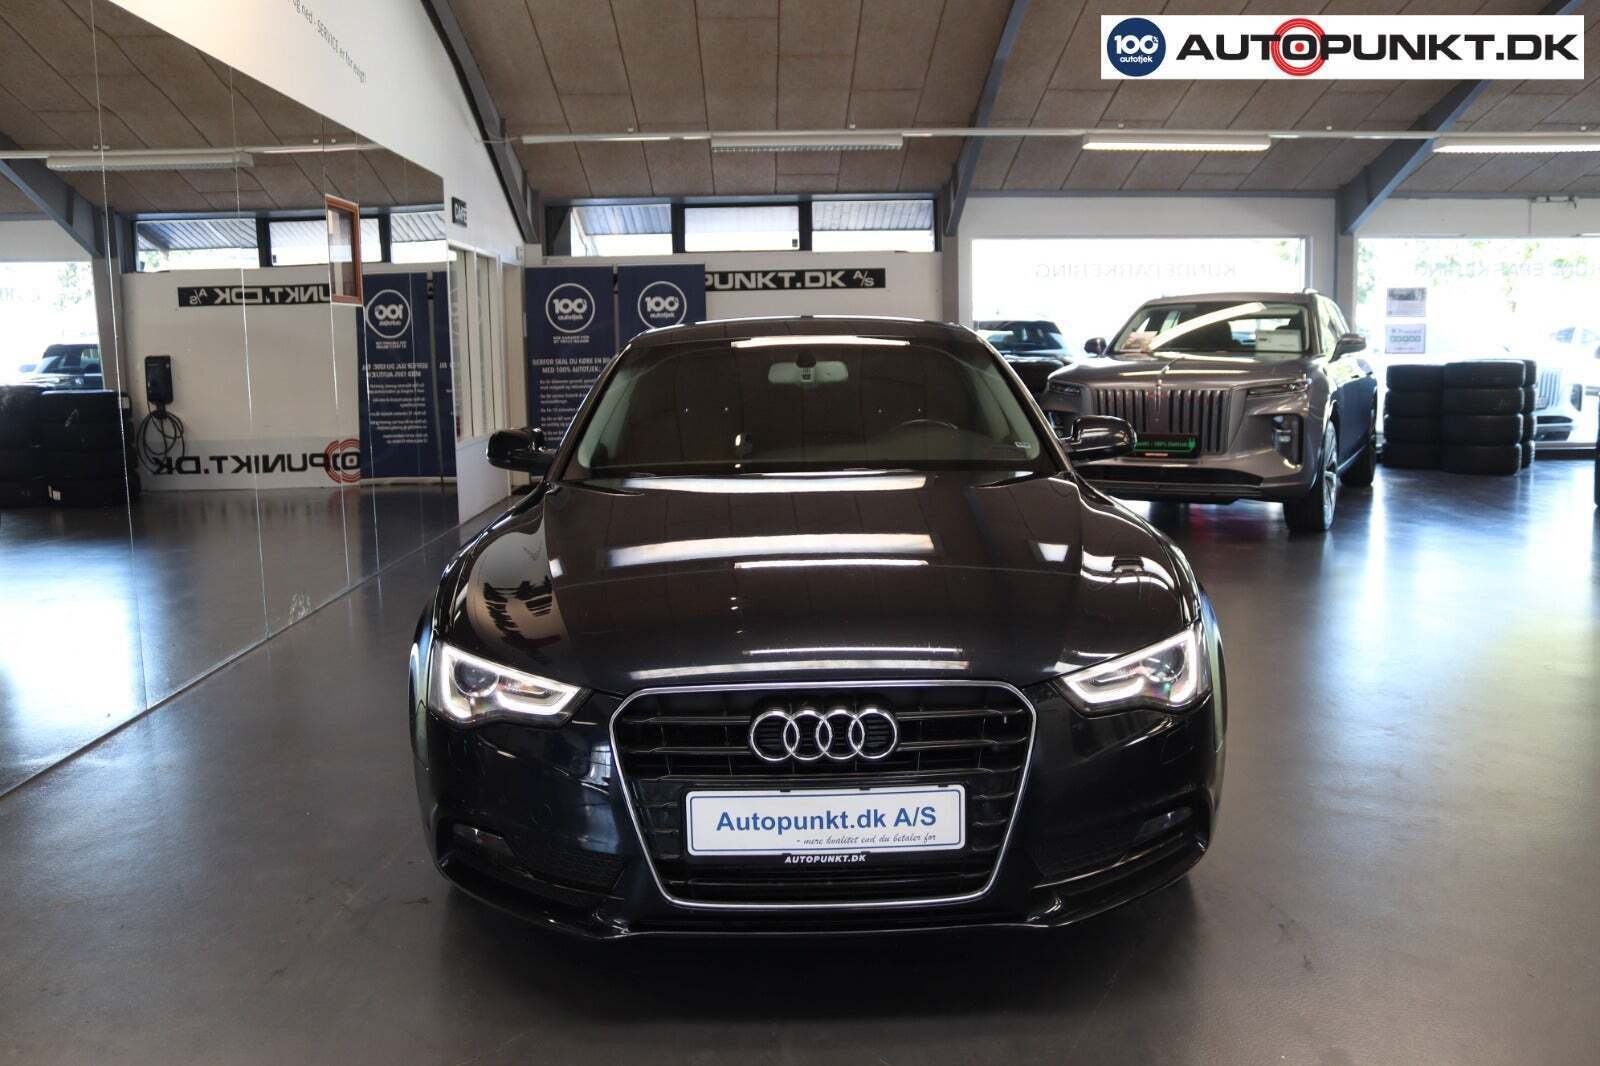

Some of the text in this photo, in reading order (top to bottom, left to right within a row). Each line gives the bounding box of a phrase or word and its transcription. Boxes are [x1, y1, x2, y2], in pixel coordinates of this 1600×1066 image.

[317, 19, 338, 54] SERVICE
[852, 270, 875, 287] A/S
[716, 806, 937, 835] Autopunkt.dk A/S
[879, 834, 892, 843] du
[893, 833, 921, 843] betaler
[784, 853, 867, 864] AUTOPUNKT.DK
